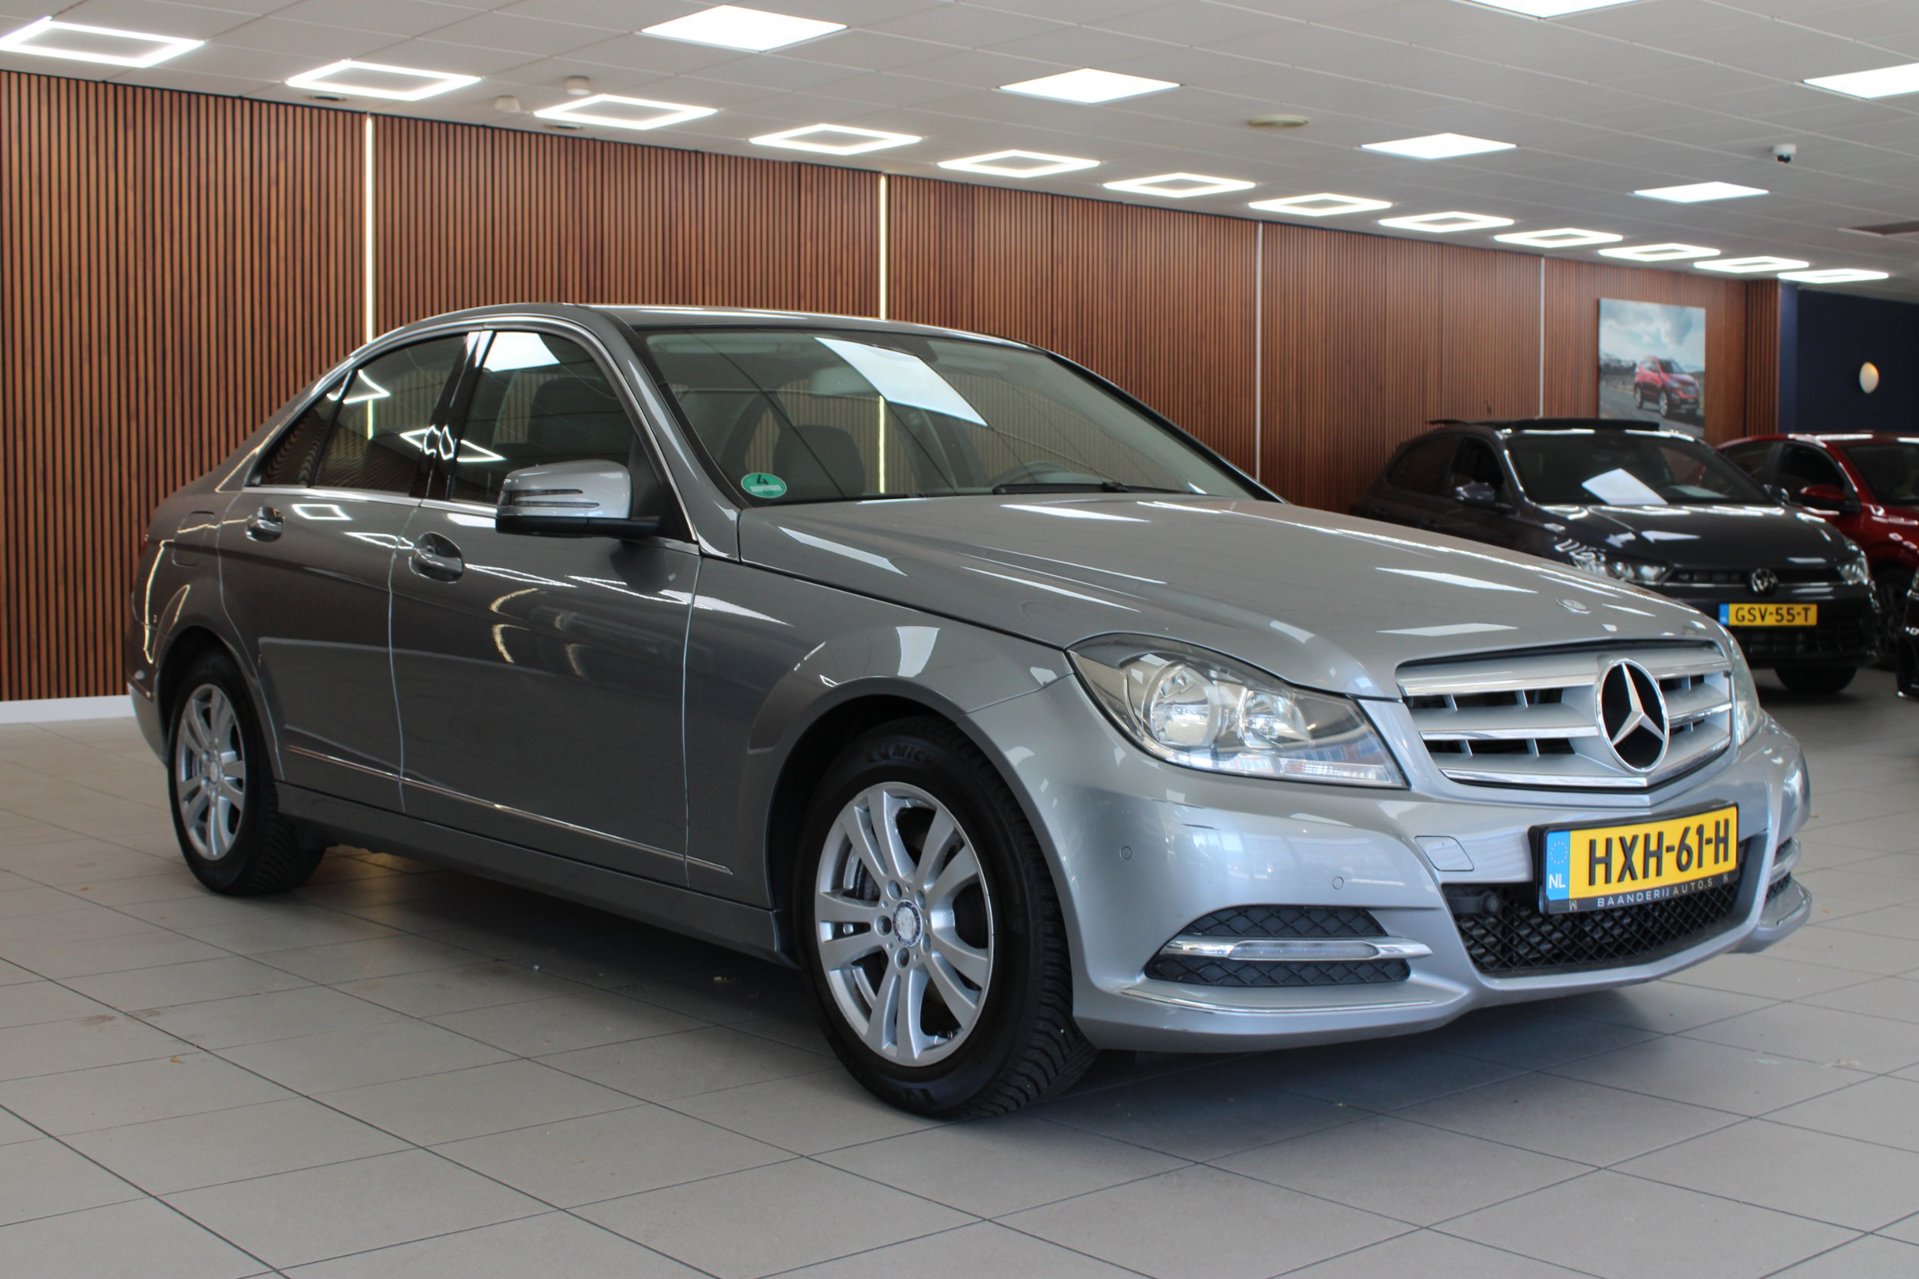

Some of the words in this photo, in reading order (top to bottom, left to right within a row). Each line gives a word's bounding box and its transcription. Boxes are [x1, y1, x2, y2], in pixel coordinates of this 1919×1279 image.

[1735, 606, 1811, 623] GSV-55-T
[1588, 818, 1730, 887] HXH-61-H
[1549, 874, 1566, 889] NL
